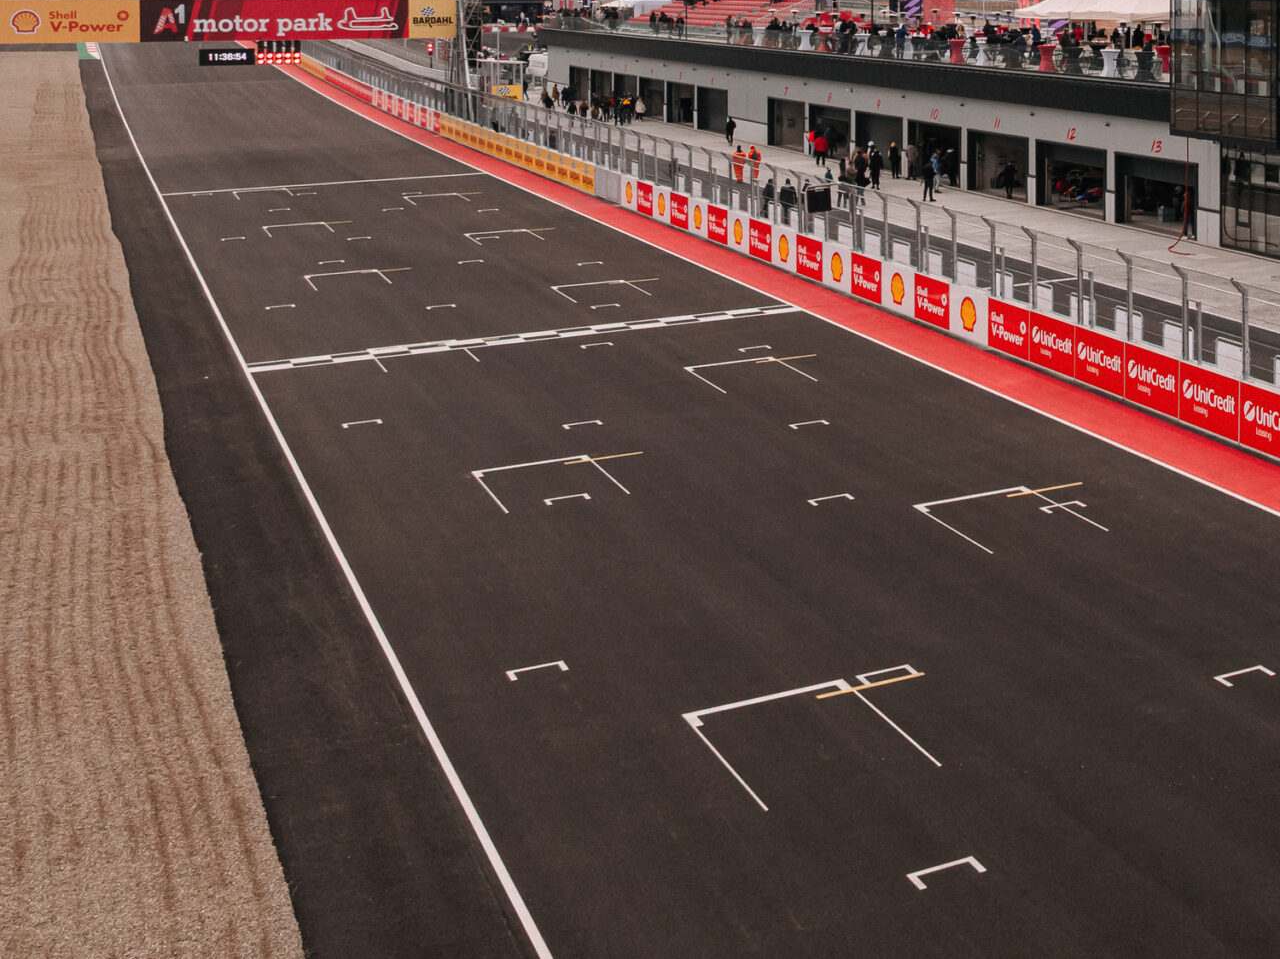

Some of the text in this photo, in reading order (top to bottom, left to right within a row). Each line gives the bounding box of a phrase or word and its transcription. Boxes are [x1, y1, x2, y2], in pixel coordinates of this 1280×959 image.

[49, 10, 77, 20] Shell
[153, 4, 333, 37] A1 motor park
[412, 16, 454, 27] BARDAHL
[50, 21, 124, 33] V-Power
[930, 108, 939, 120] 10
[1066, 127, 1076, 140] 12
[1150, 139, 1162, 153] 13
[798, 254, 820, 271] V-Power
[853, 273, 878, 293] V-Power
[917, 285, 928, 298] Shell
[917, 297, 945, 317] V-Power
[991, 311, 1004, 324] Shell
[991, 323, 1024, 347] V-Power
[1041, 327, 1072, 355] UniCredit
[1086, 345, 1121, 373] UniCredit
[1138, 366, 1176, 393] UniCredit
[1194, 387, 1235, 415] UniCredit
[1256, 427, 1272, 441] Leasing
